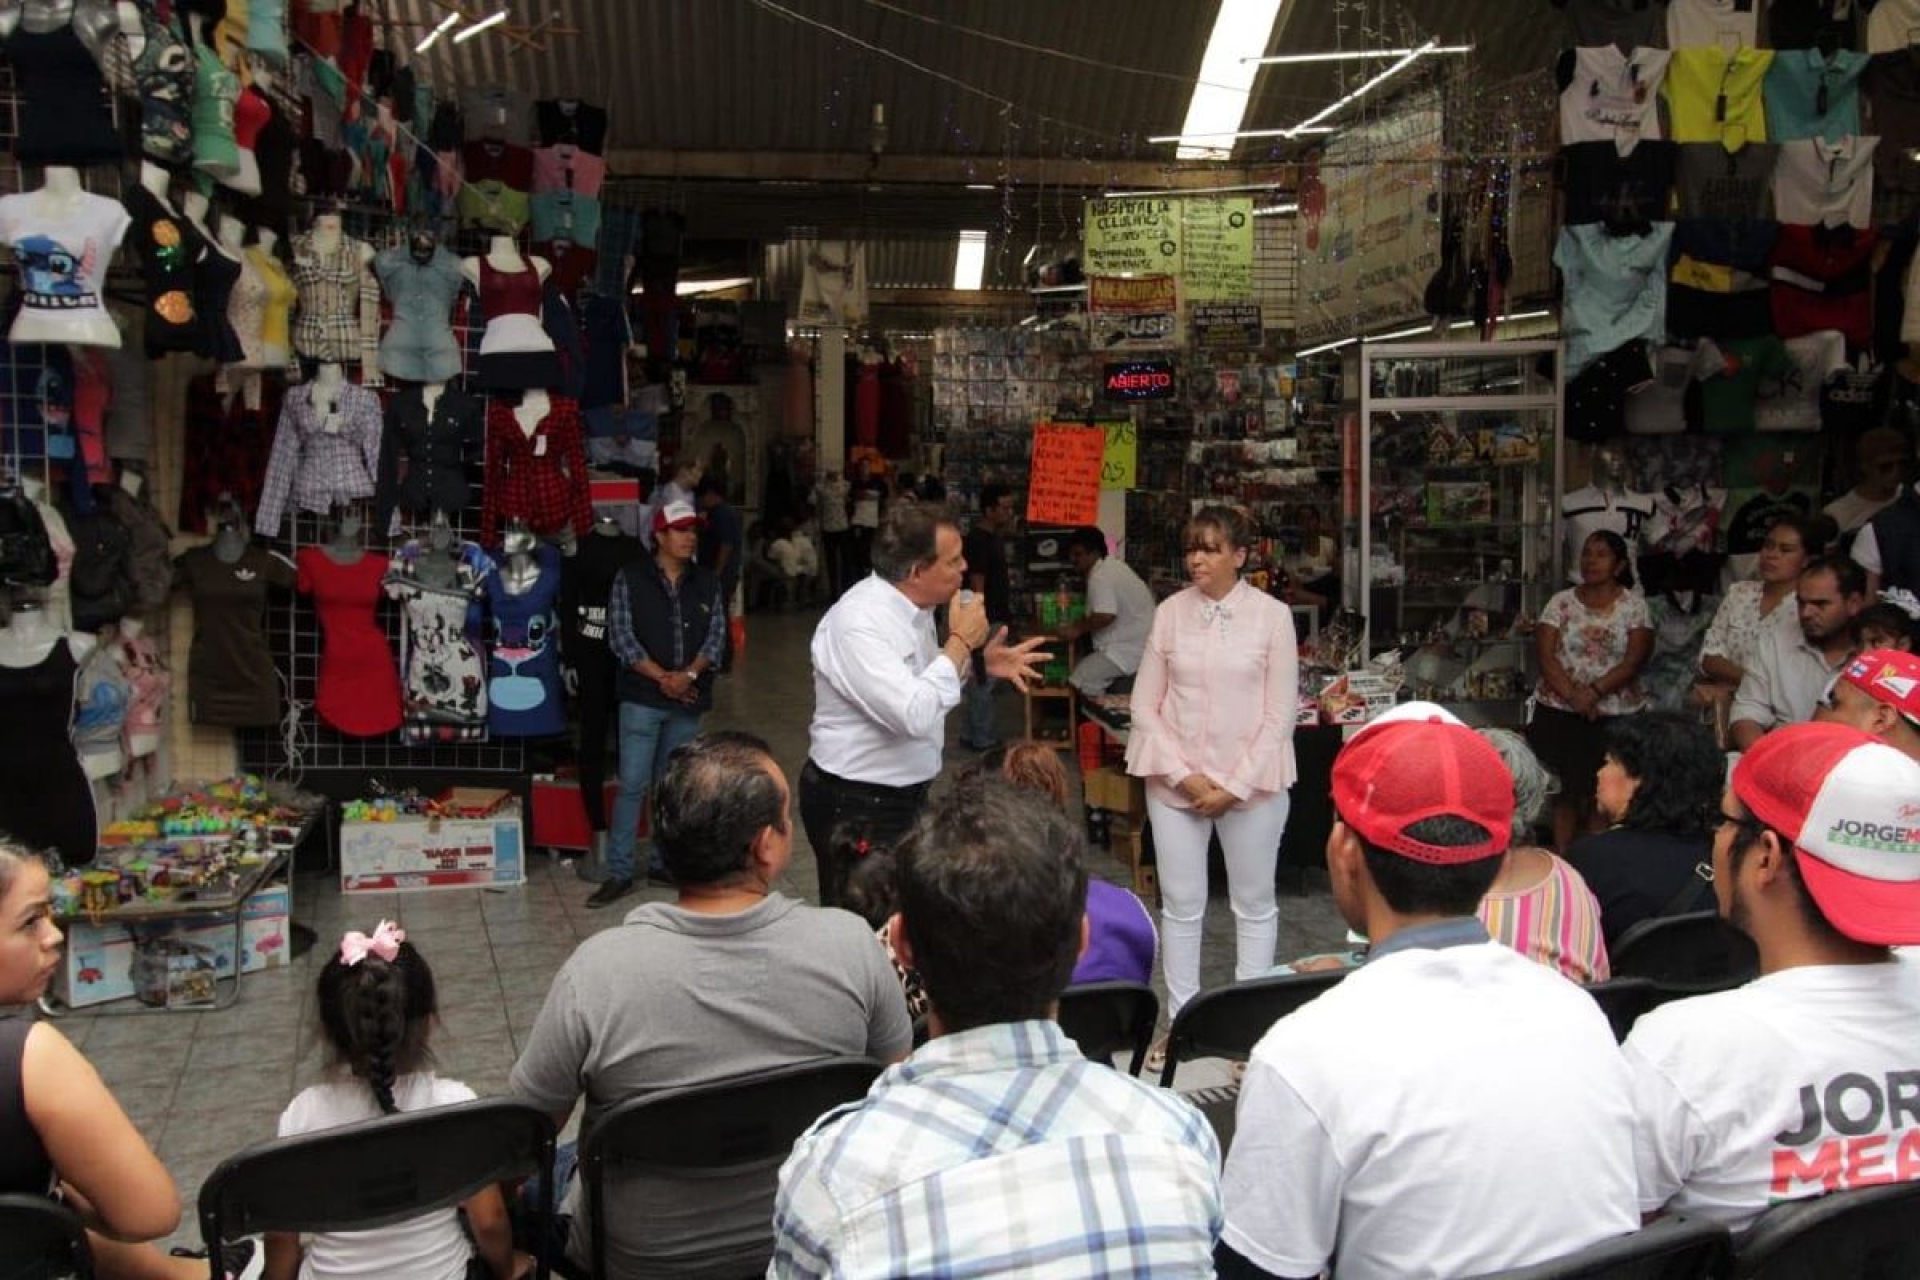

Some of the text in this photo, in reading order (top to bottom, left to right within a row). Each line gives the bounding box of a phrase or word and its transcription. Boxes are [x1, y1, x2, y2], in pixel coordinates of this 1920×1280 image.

[1129, 317, 1175, 336] USB
[1107, 373, 1171, 389] ABIERTO
[1774, 1070, 1920, 1146] JOR
